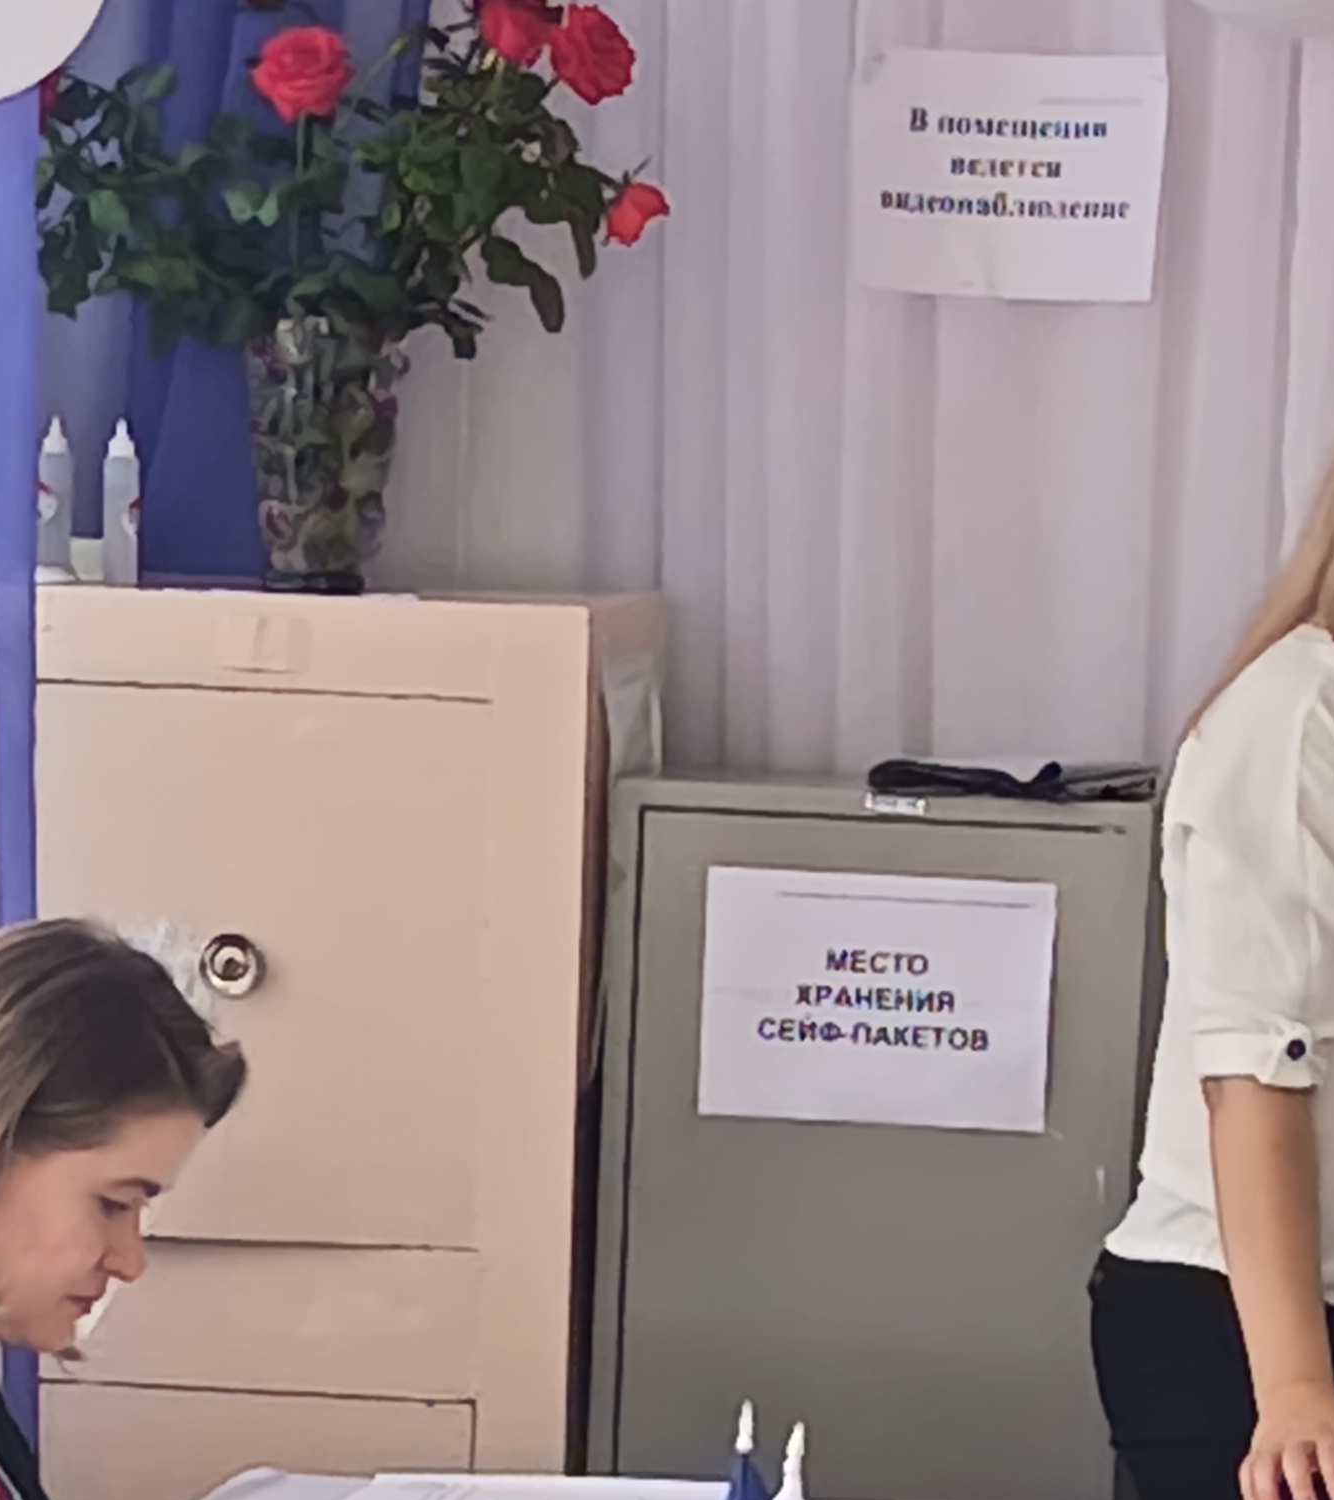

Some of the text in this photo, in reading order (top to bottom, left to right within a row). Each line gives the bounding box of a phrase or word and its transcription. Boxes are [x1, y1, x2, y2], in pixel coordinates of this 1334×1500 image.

[909, 106, 929, 133] В
[824, 948, 929, 976] МЕСТО
[794, 984, 956, 1014] ХРАНЕНИЯ
[756, 1014, 990, 1052] СЕЙФ-ПАКЕТОВ
